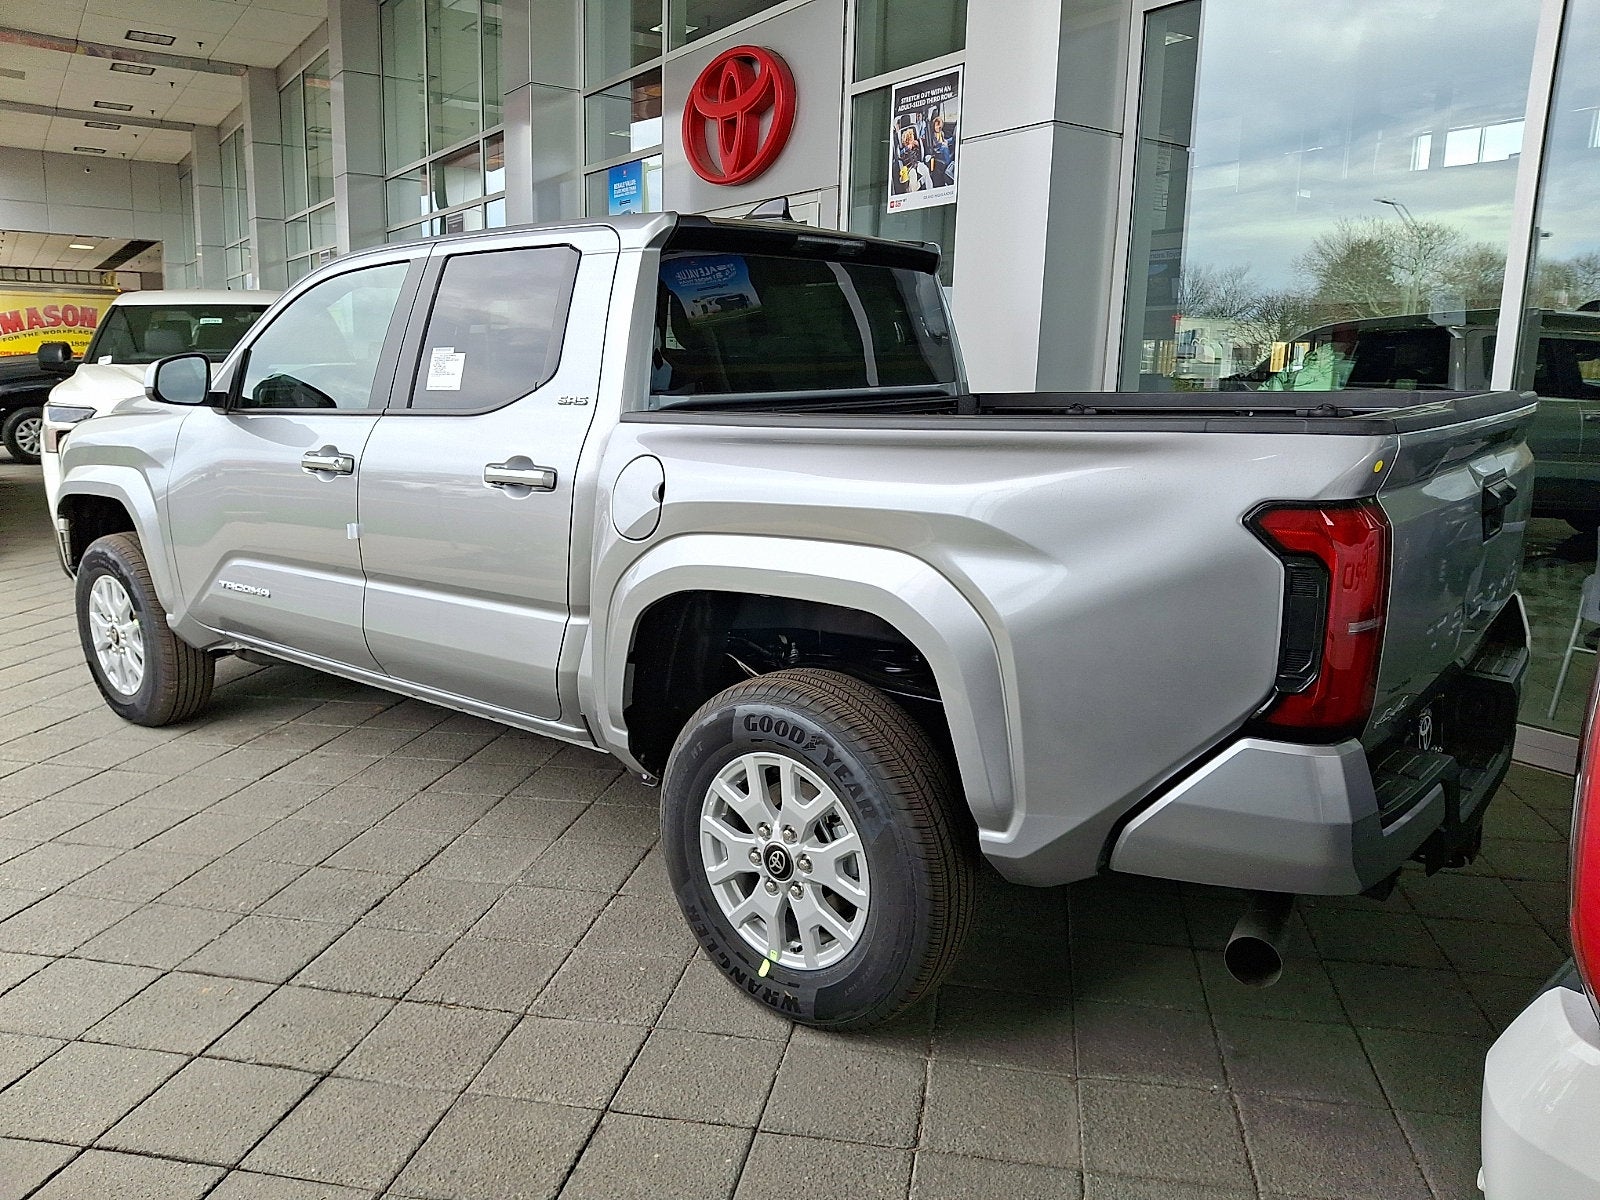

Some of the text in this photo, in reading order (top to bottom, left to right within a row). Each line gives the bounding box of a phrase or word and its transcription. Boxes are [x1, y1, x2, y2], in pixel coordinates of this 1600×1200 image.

[920, 91, 930, 99] OUT
[931, 87, 944, 96] WITH
[943, 84, 952, 93] AN
[0, 304, 98, 335] MASON
[3, 333, 20, 342] FOR
[23, 331, 38, 339] THE
[218, 579, 271, 598] TACOMA
